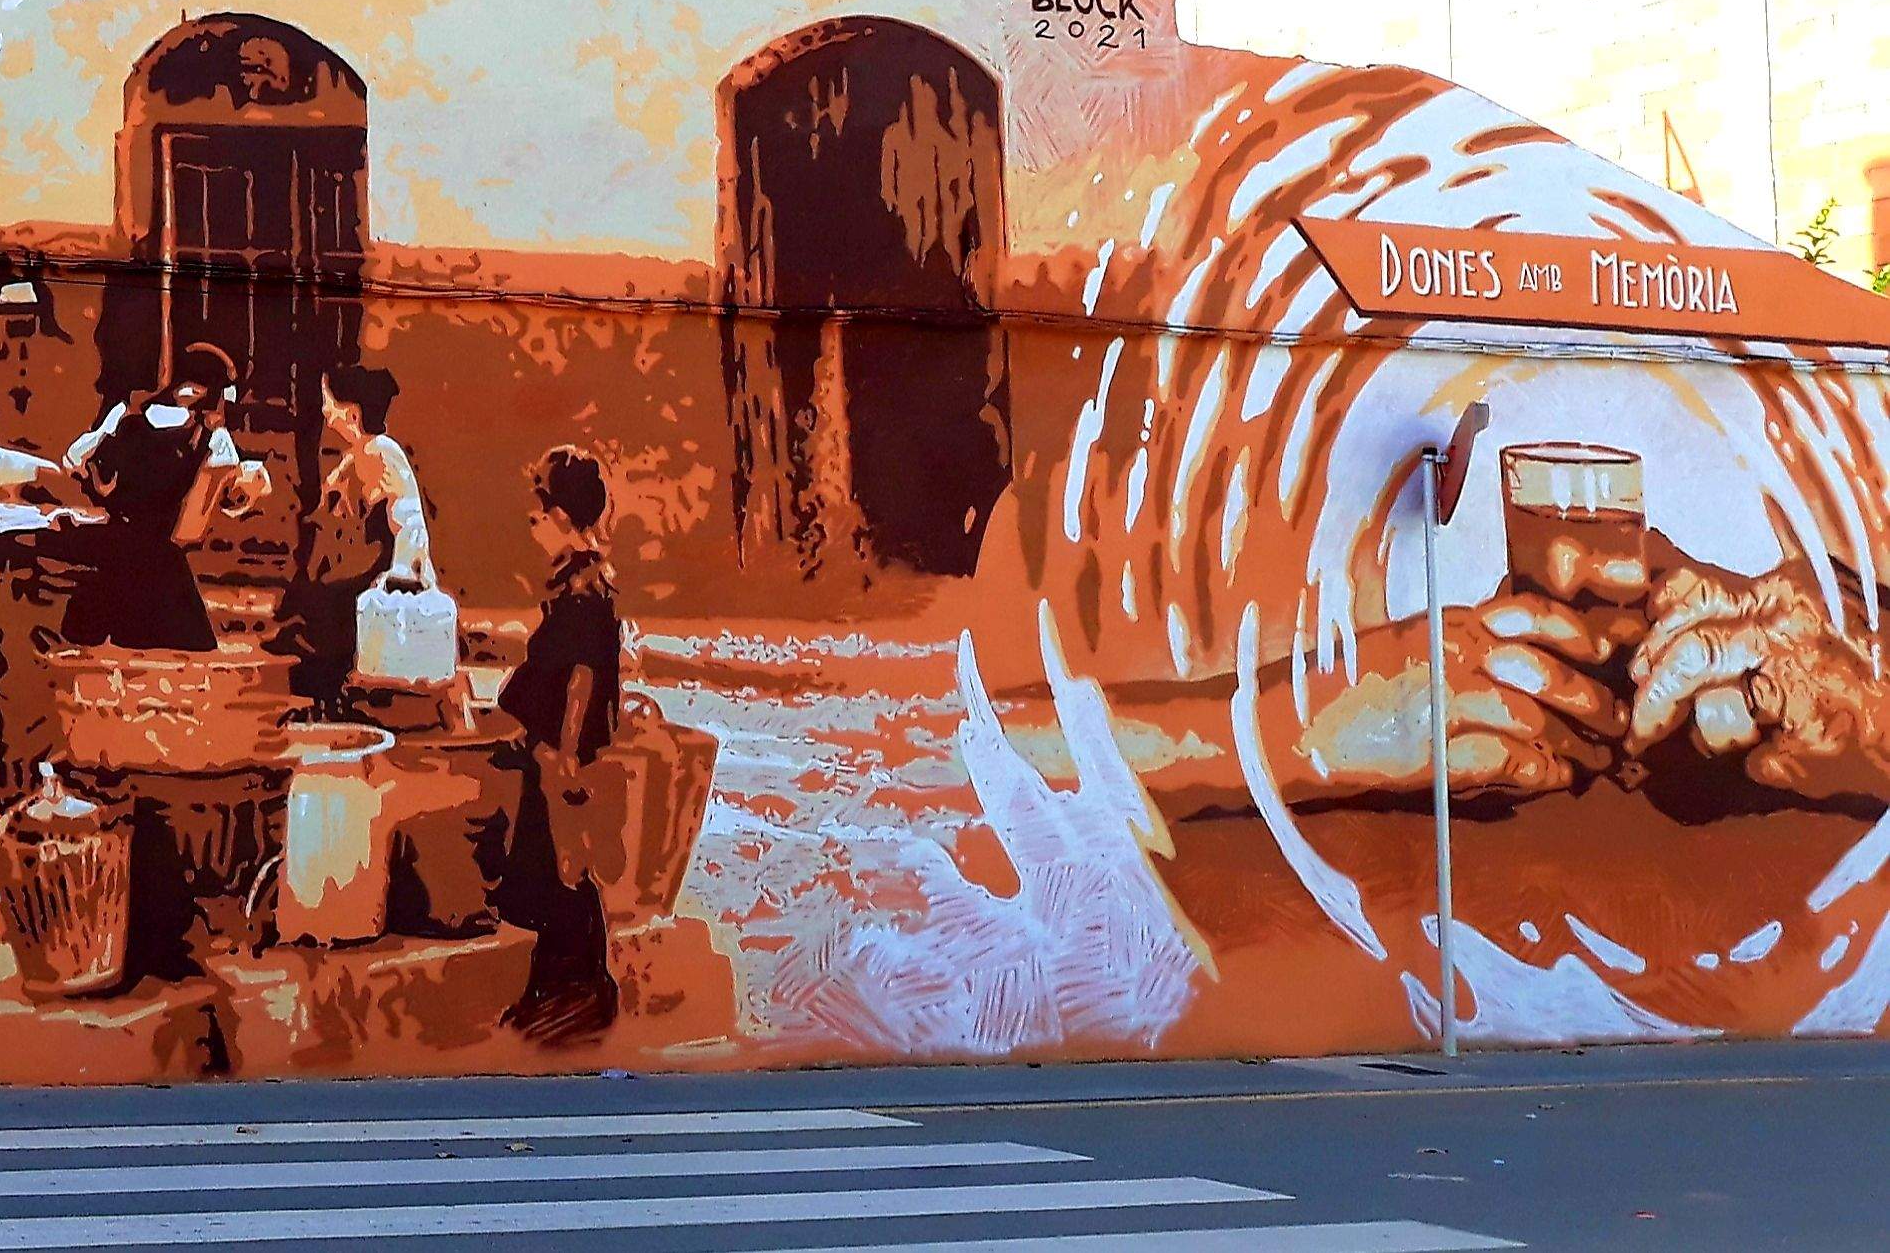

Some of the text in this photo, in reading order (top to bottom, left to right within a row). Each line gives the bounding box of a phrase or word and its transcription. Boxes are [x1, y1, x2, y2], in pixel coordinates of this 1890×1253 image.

[1034, 19, 1146, 49] 2021
[1379, 233, 1740, 316] DONES AMB MEMÒRIA
